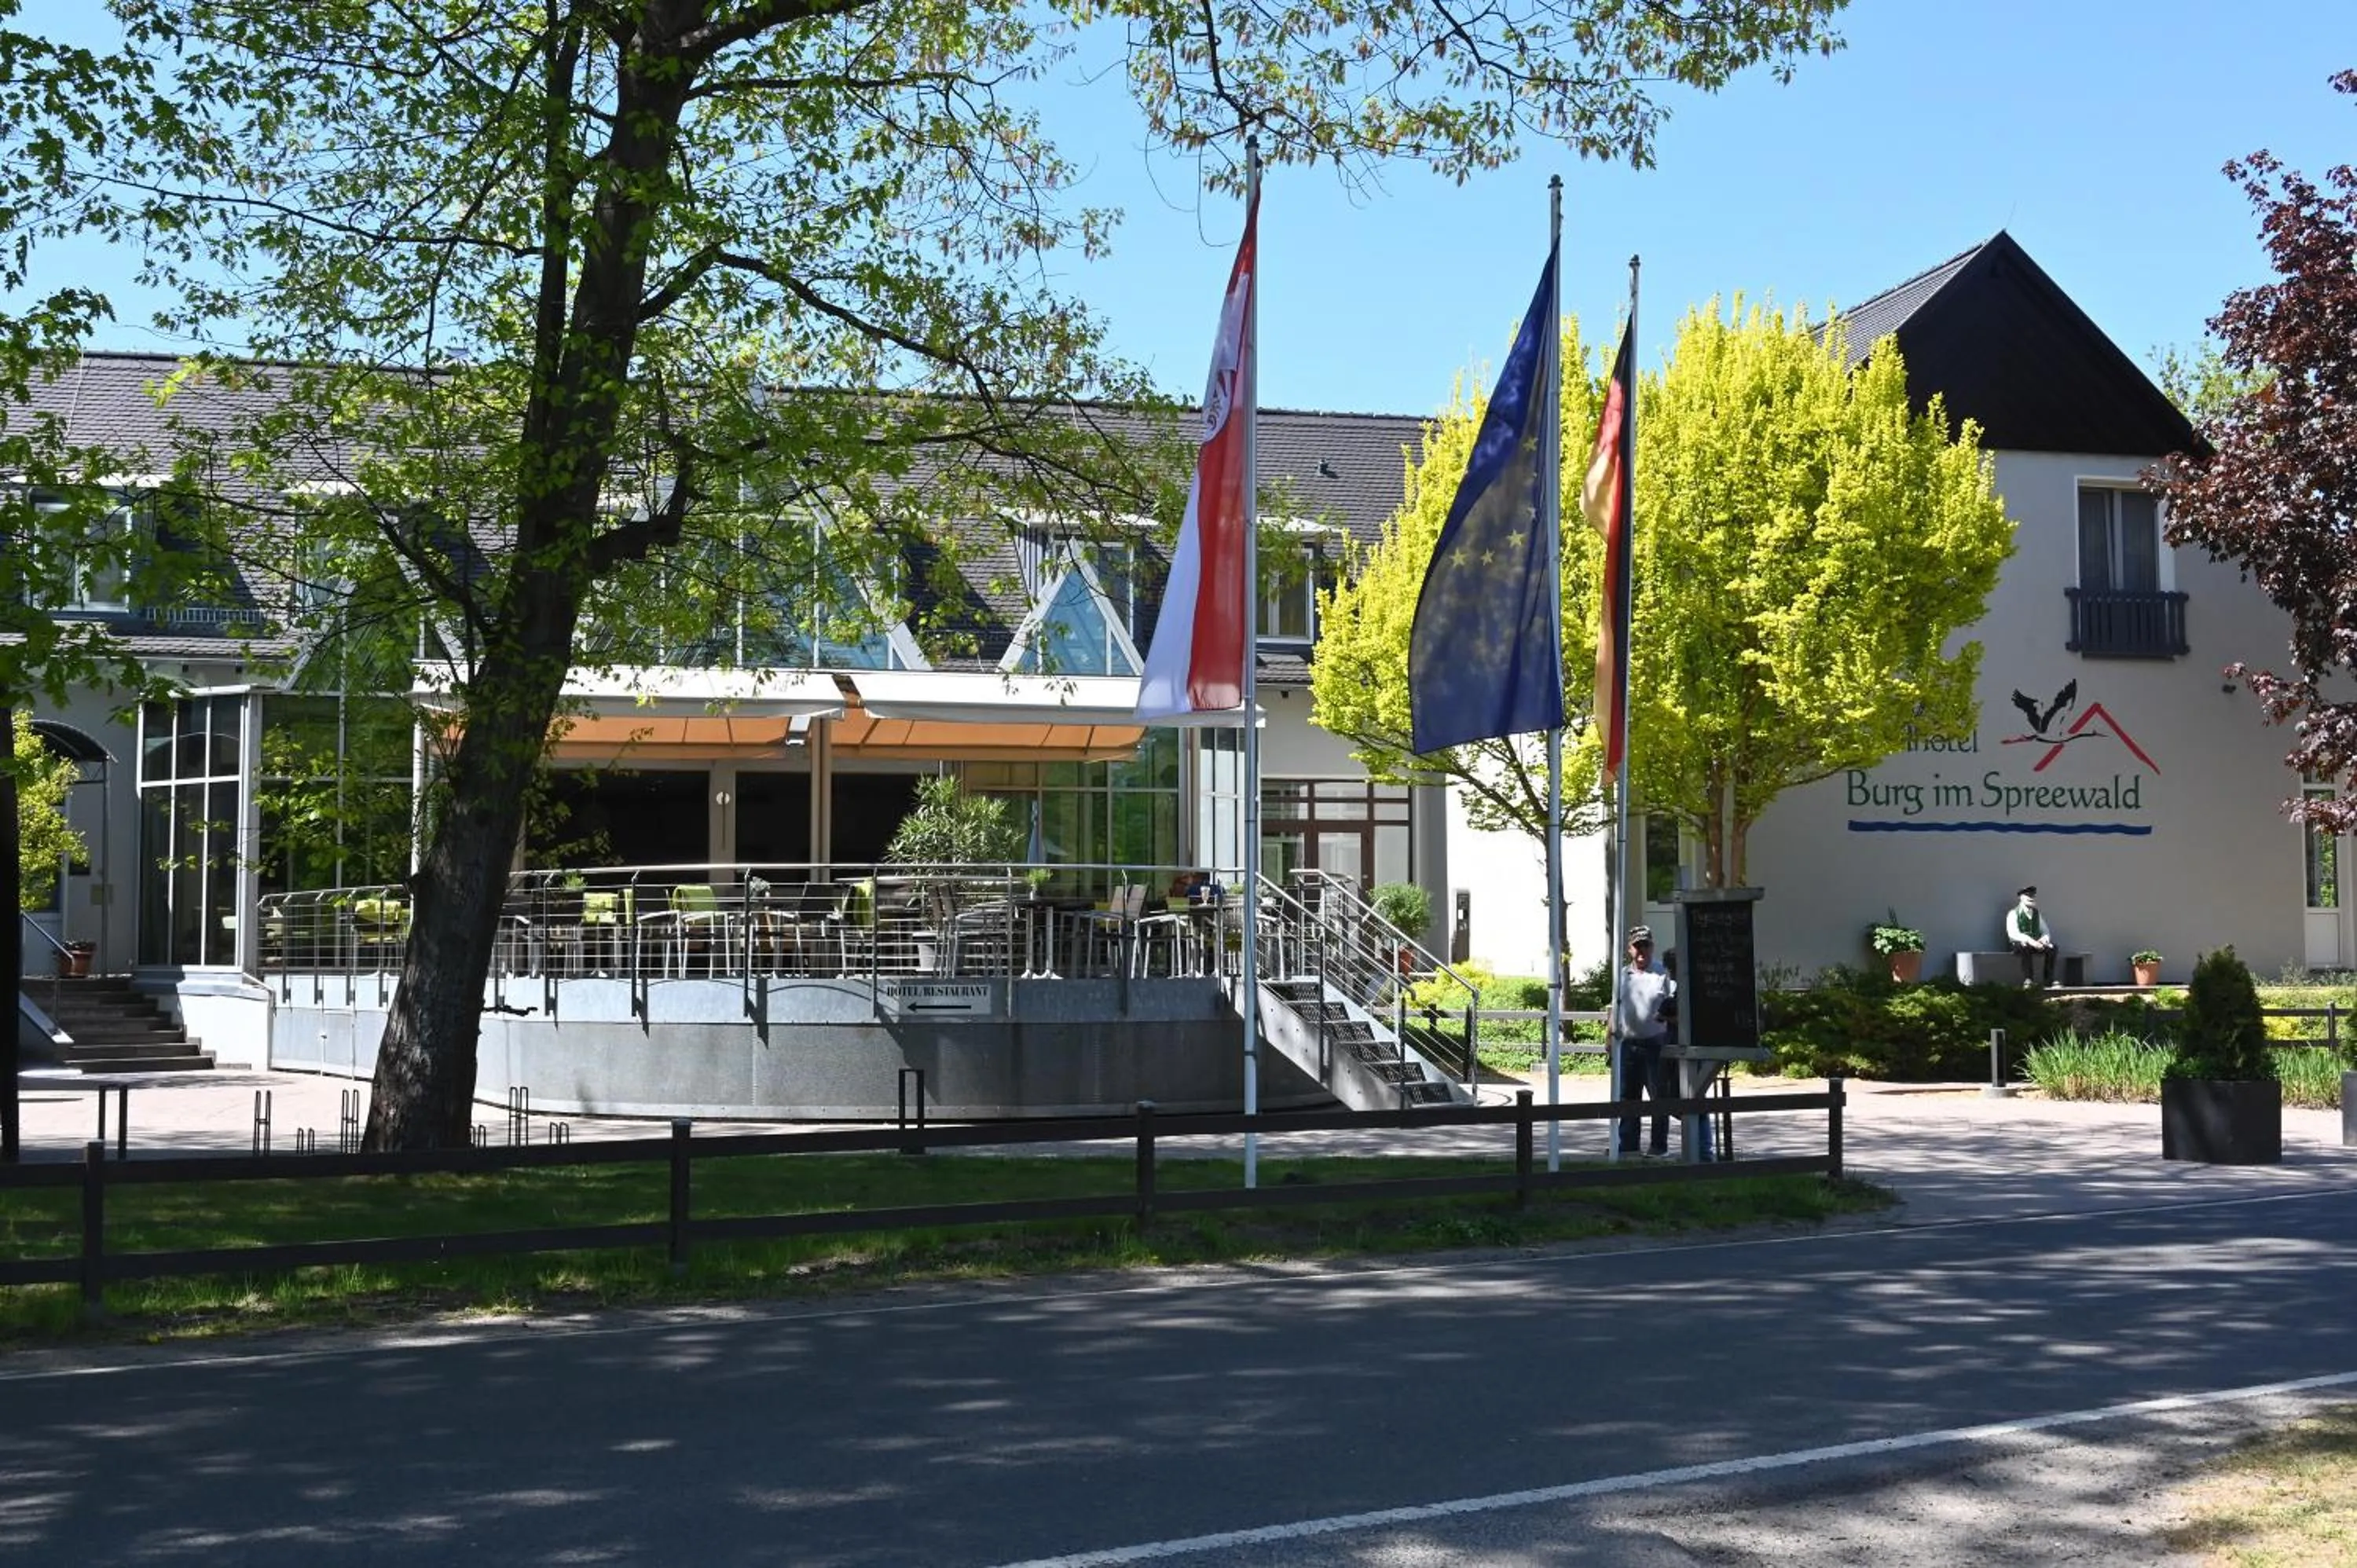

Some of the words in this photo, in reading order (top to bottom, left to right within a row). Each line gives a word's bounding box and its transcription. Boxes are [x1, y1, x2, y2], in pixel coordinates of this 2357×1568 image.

[1847, 769, 1923, 815] Burg
[1934, 773, 1974, 807] im
[1981, 771, 2141, 815] Spreewald
